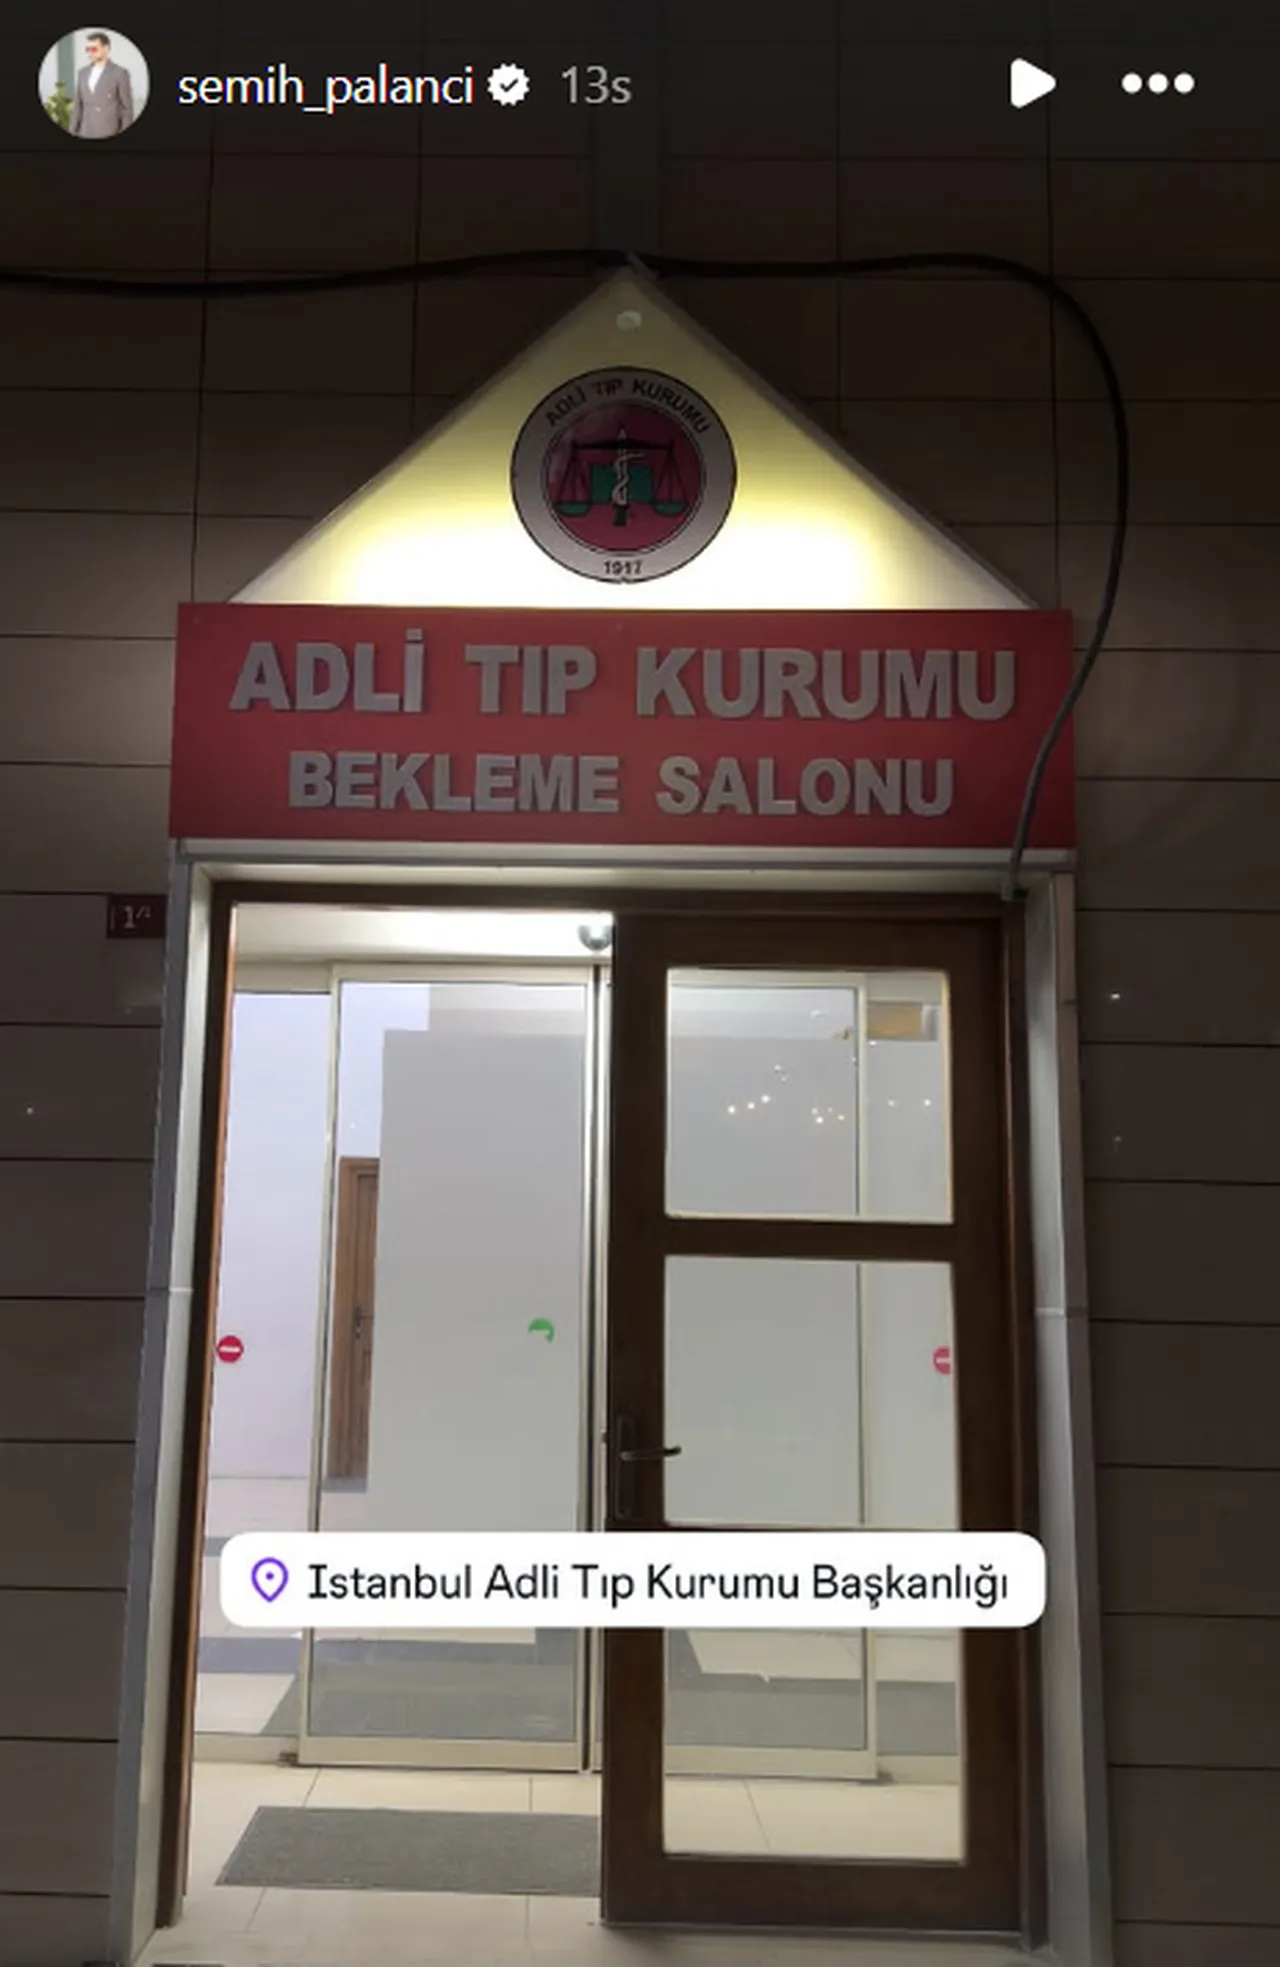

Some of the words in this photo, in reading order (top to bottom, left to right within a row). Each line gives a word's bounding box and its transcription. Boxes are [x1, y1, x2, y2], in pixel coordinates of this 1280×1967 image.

[631, 379, 711, 434] KURUMU
[603, 560, 643, 575] 1917
[229, 628, 425, 713] ADLİ
[465, 645, 598, 715] TIP
[636, 646, 1016, 721] KURUMU
[288, 750, 620, 813] BEKLEME
[656, 755, 955, 817] SALONU
